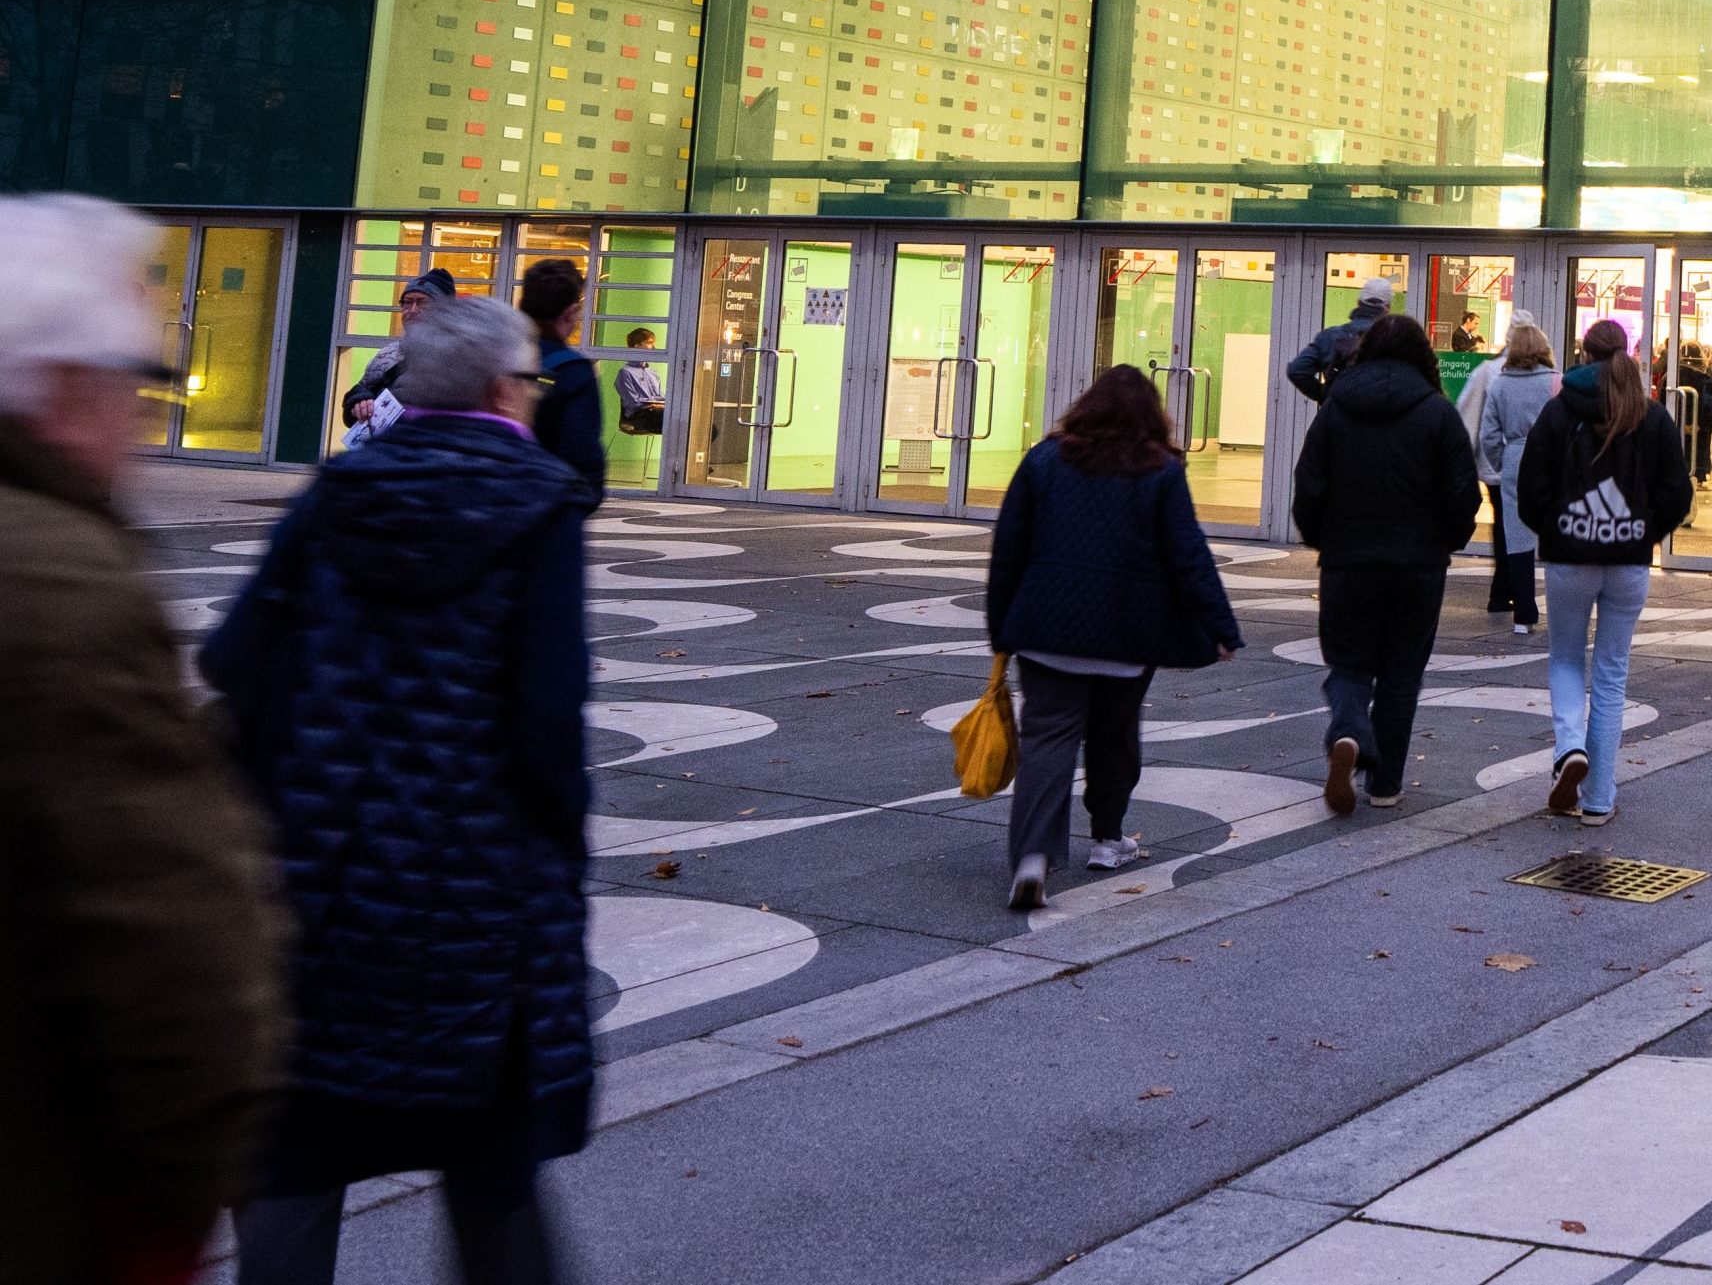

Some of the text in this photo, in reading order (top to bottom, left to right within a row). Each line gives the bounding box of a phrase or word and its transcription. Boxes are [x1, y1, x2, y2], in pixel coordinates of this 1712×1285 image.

[727, 289, 753, 300] Congress
[726, 302, 745, 311] Center
[1438, 358, 1471, 370] Eingang
[1558, 513, 1646, 544] adidas
